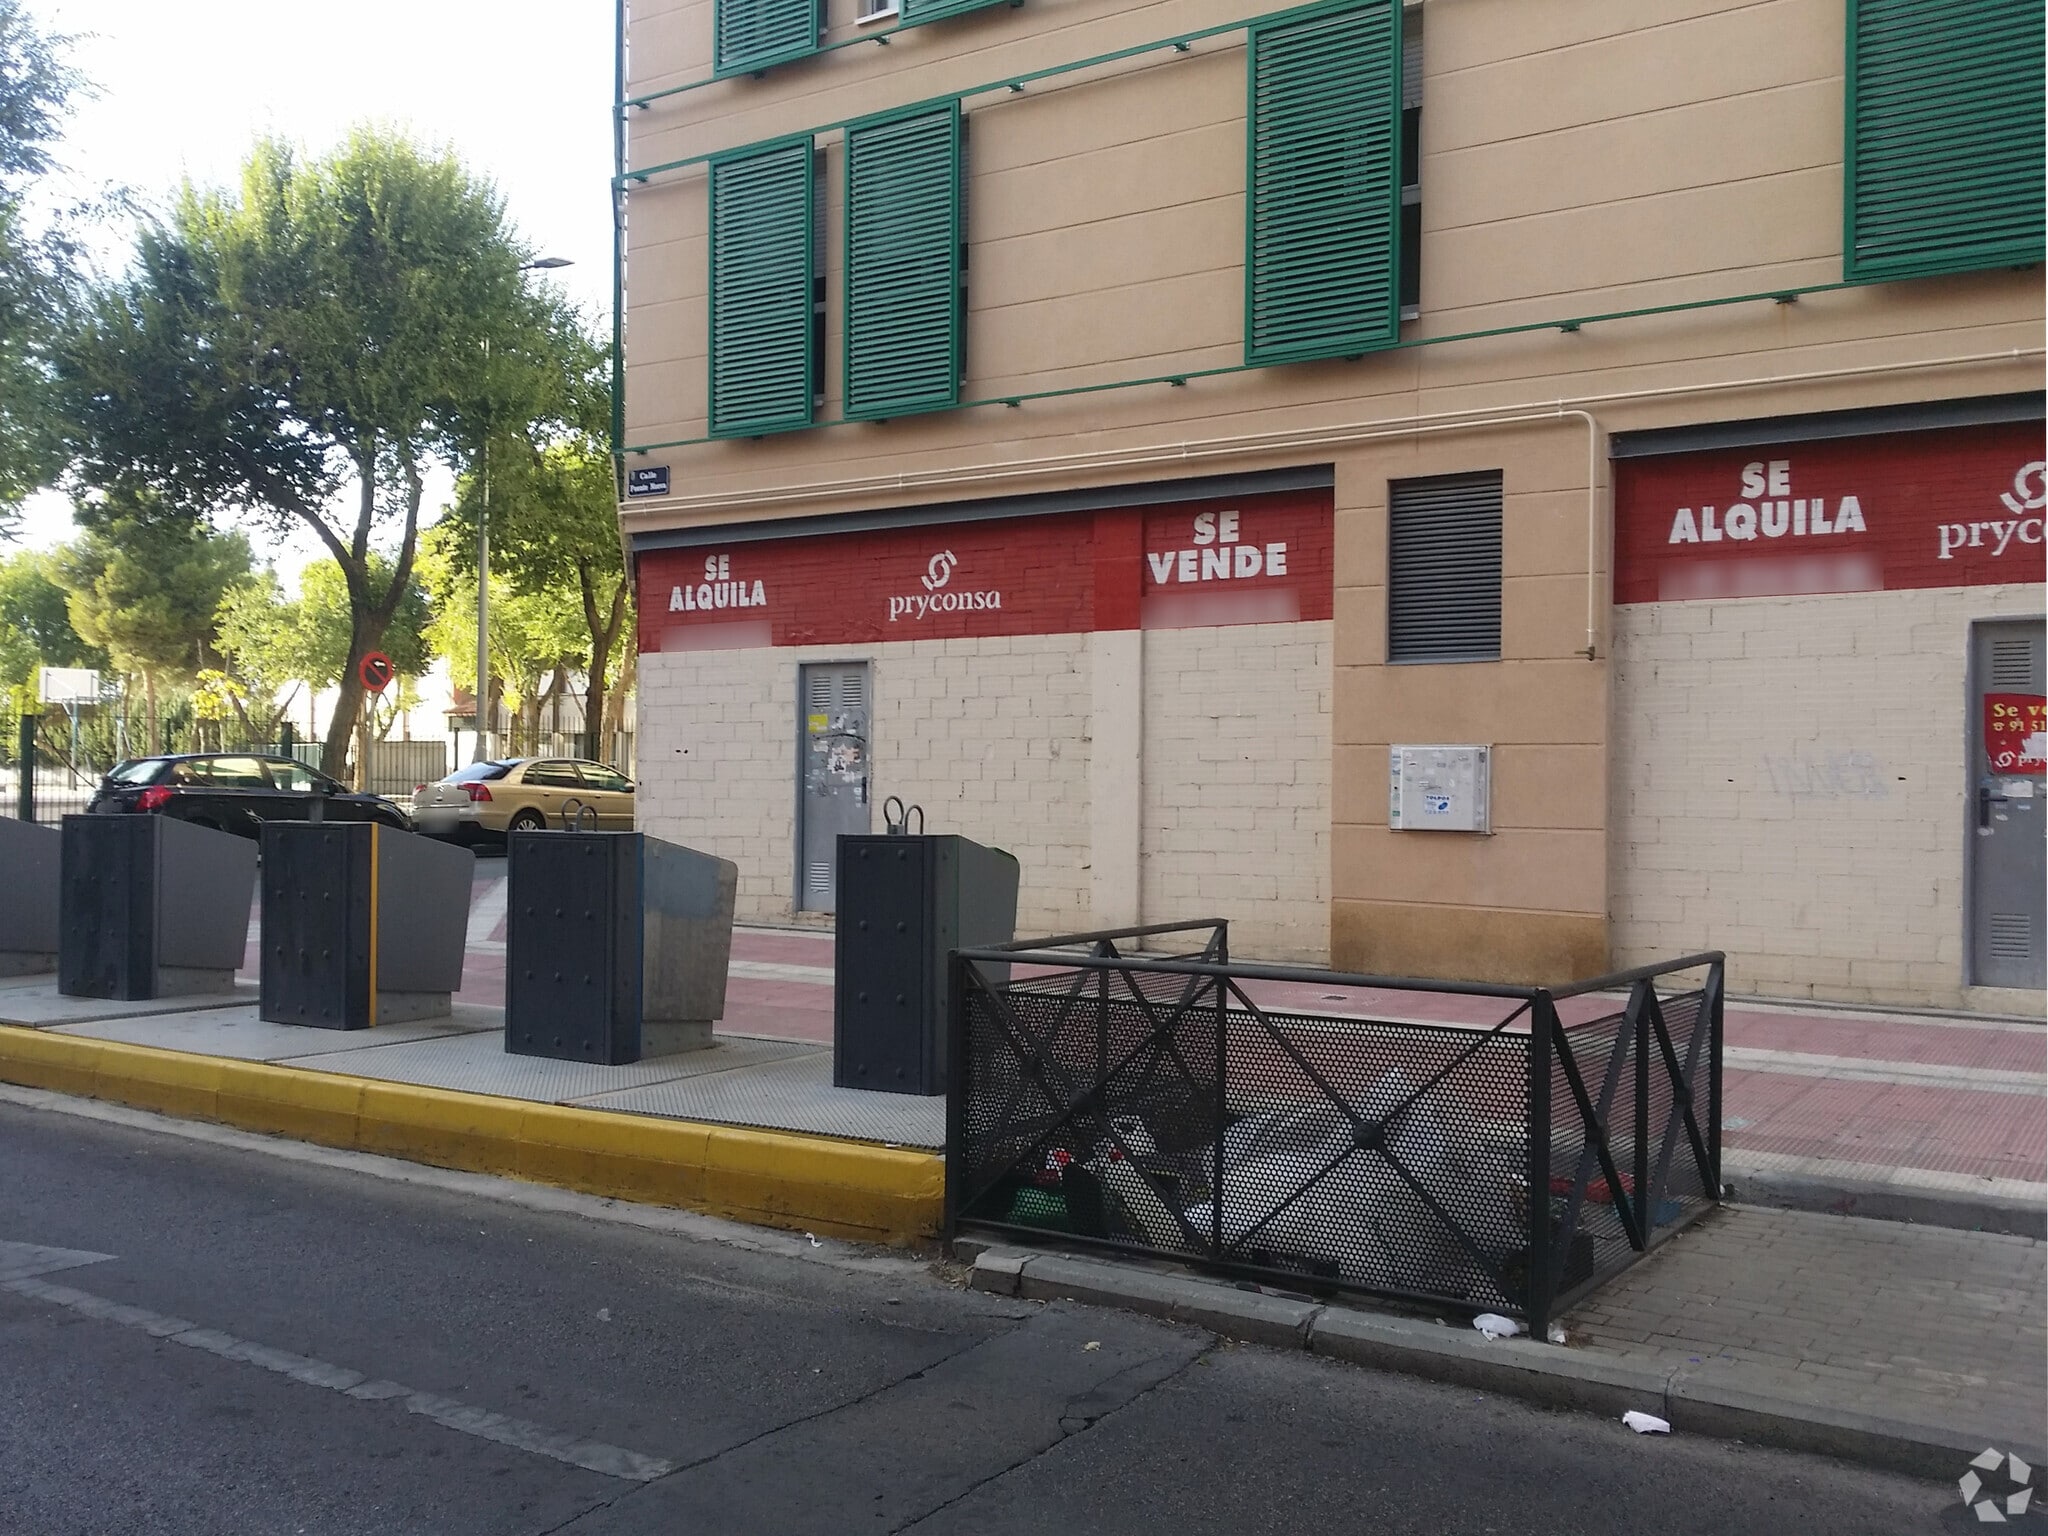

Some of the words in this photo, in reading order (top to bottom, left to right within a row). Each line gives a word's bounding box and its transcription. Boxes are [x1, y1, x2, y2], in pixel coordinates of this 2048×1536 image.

[639, 471, 657, 480] Calle
[1741, 460, 1790, 499] SE
[1193, 510, 1240, 545] SE
[1668, 496, 1867, 544] ALQUILA
[704, 554, 730, 581] SE
[1147, 542, 1288, 585] VENDE
[668, 580, 767, 612] ALQUILA
[888, 590, 1001, 622] pryconsa
[1993, 703, 2019, 718] Se
